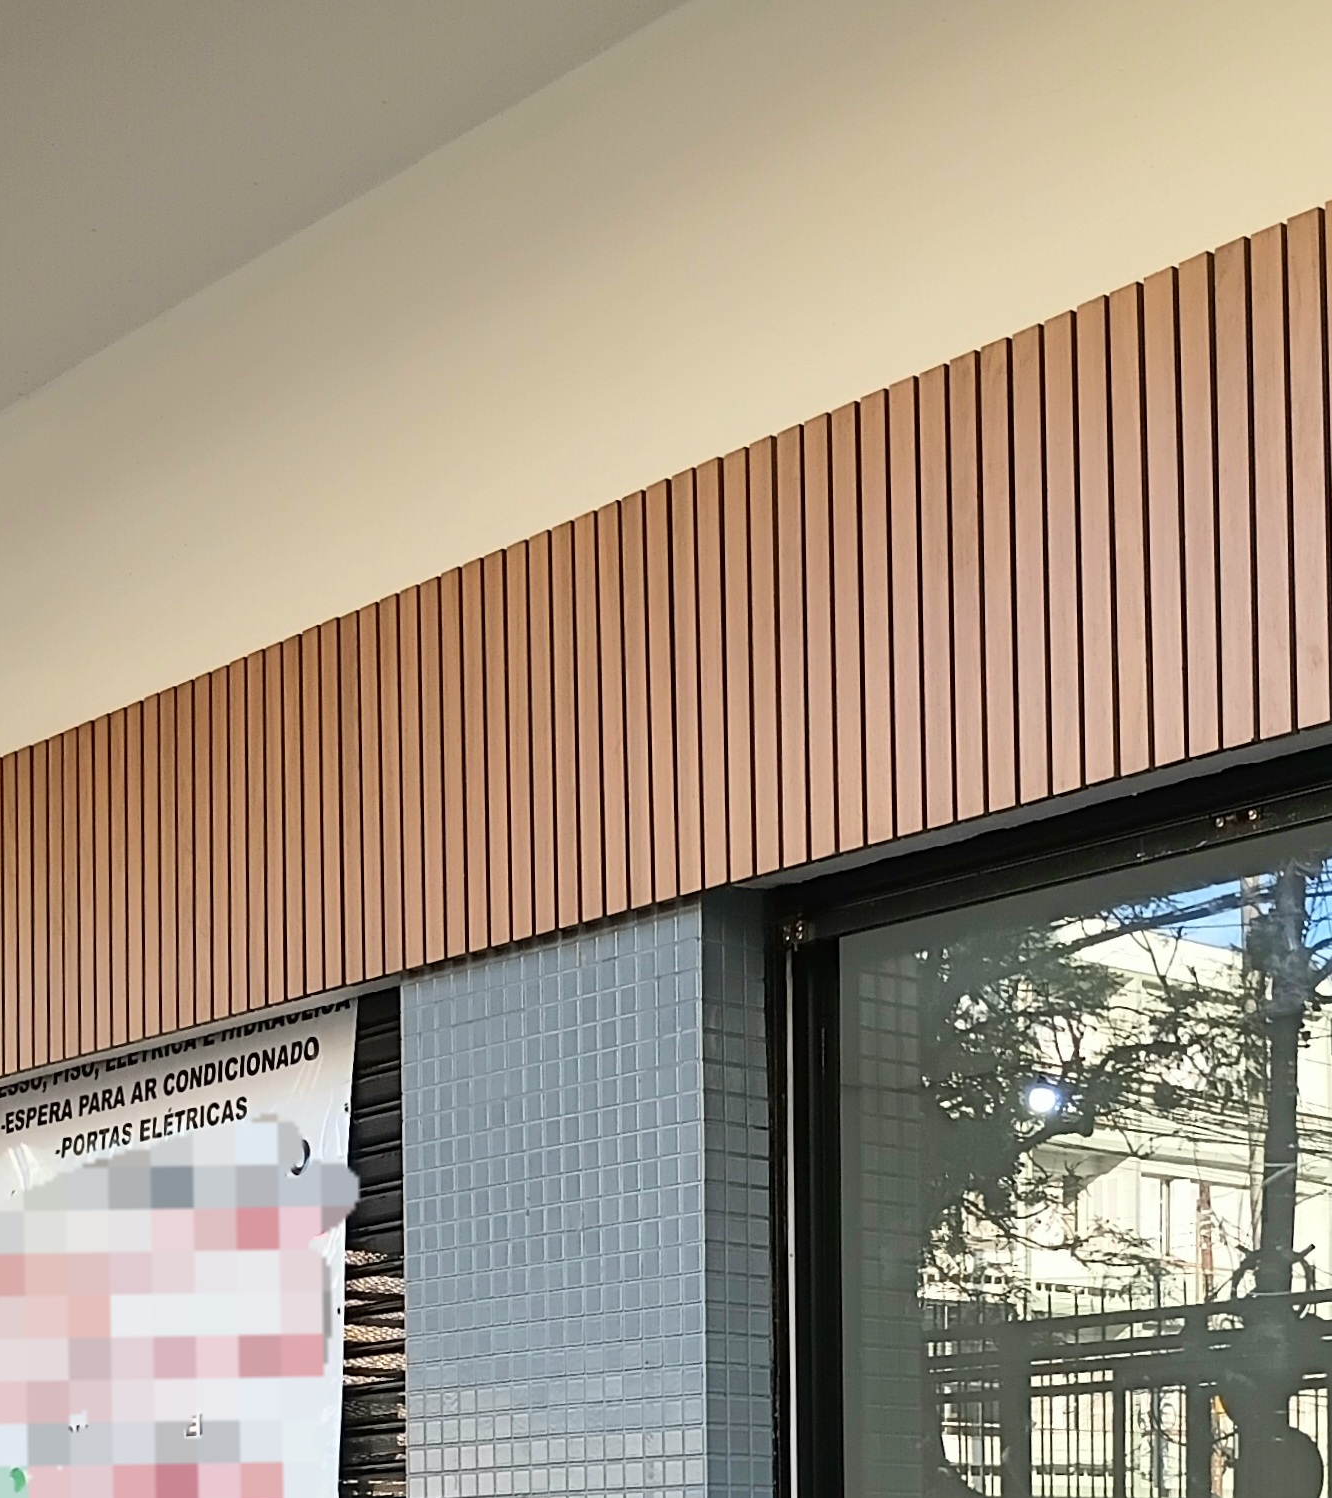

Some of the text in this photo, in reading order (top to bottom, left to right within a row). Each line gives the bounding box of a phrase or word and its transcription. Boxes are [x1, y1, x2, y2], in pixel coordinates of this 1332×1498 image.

[1, 1036, 320, 1134] -ESPERA PARA AR CONDICIONADO
[55, 1096, 248, 1158] -PORTAS ELÉTRICAS
